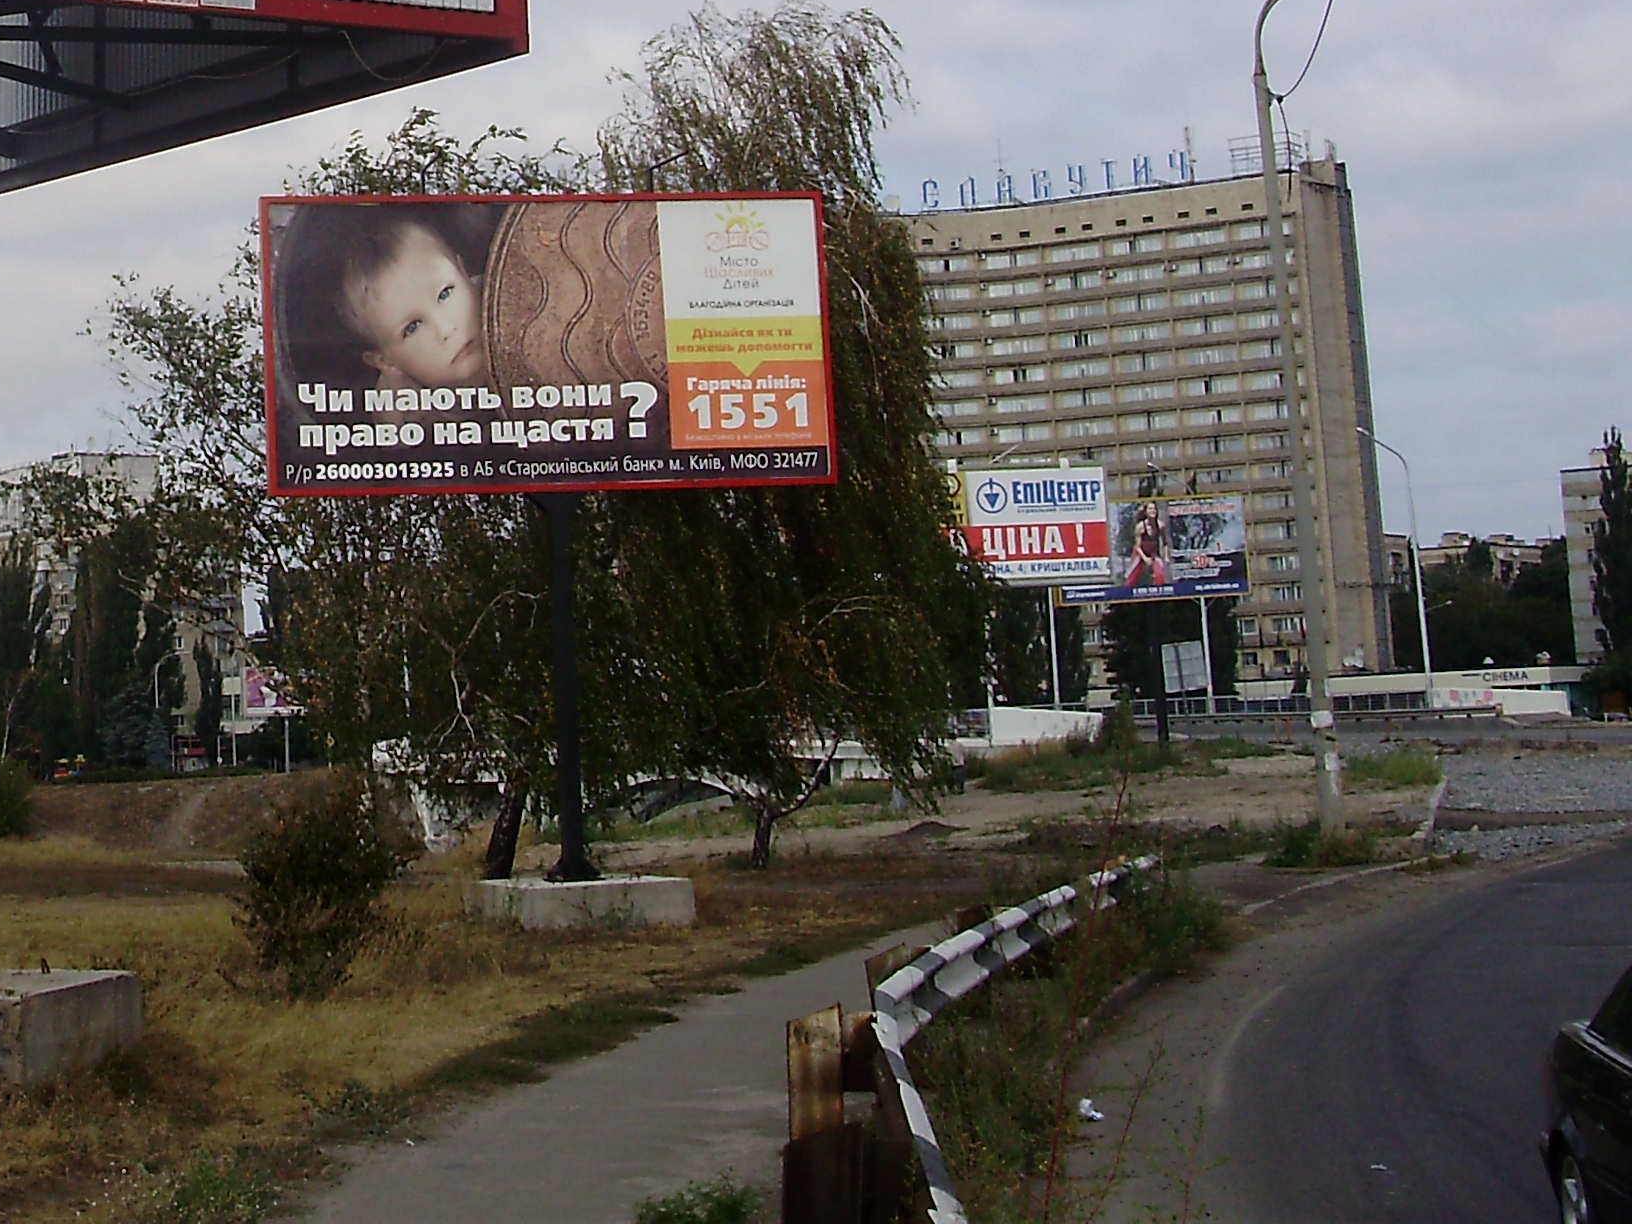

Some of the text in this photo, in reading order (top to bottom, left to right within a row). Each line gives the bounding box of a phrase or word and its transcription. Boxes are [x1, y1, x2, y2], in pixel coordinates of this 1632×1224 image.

[922, 150, 1189, 208] СЛАВУТИЧ
[720, 256, 759, 267] Місто
[723, 278, 759, 290] Дітей
[692, 328, 792, 340] Дізнайся як ти
[738, 342, 813, 354] допомогти
[686, 375, 807, 394] Гаряча лінія:
[298, 381, 658, 438] Чи мають вони ?
[687, 392, 809, 429] 1551
[299, 418, 614, 455] право на щастя
[285, 451, 818, 484] Р/р 260003013925 в АБ «Старокиївський банк» м. Київ, МФО 321477
[1011, 479, 1101, 506] ЕПІЦЕНТР
[982, 526, 1065, 560] ЦІНА
